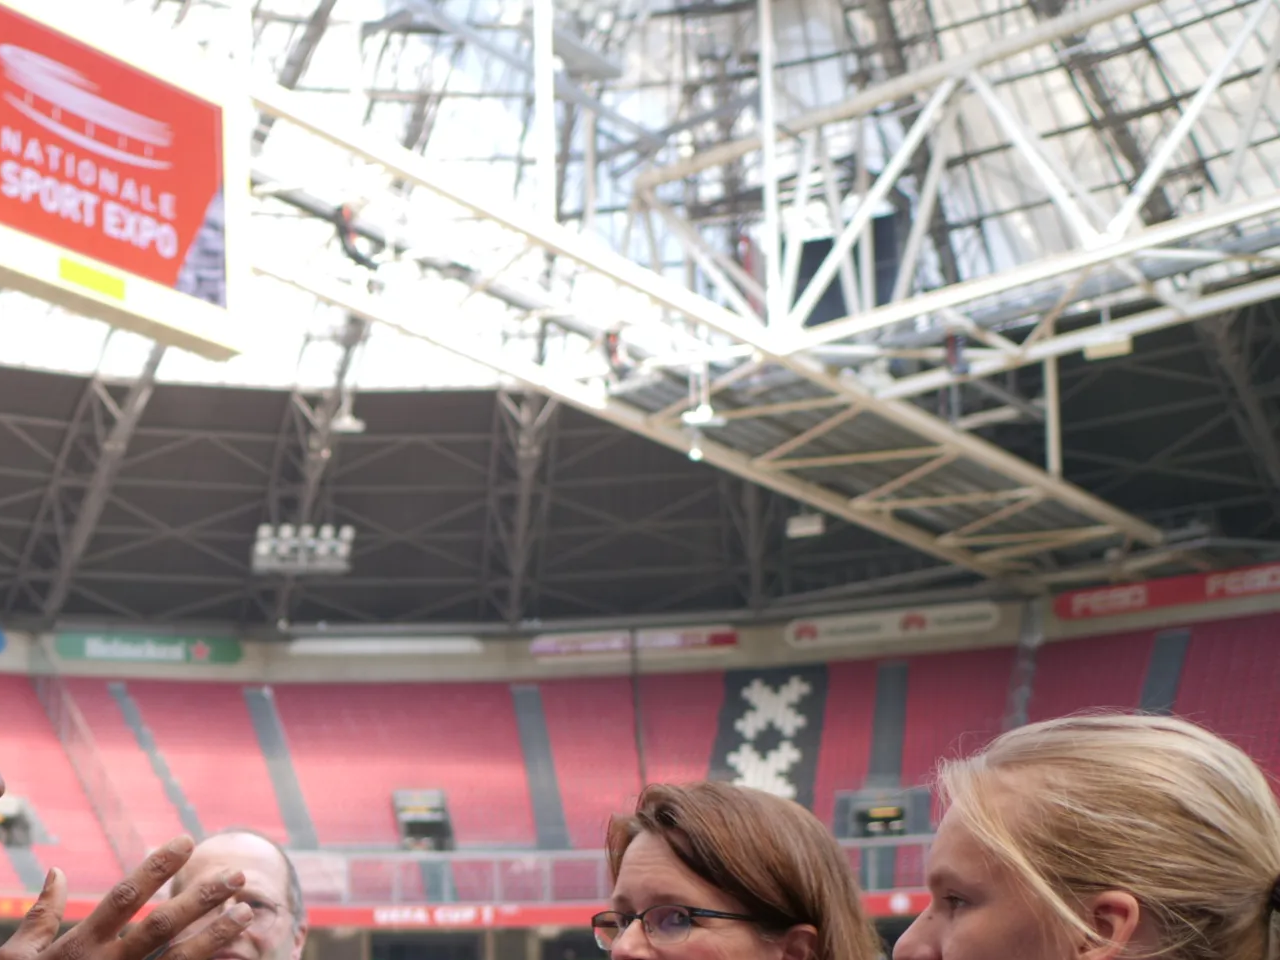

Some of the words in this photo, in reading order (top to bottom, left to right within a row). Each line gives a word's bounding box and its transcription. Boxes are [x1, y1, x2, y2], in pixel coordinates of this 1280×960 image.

[0, 125, 177, 220] NATIONALE
[0, 159, 98, 228] SPORT
[102, 201, 179, 260] EXPO
